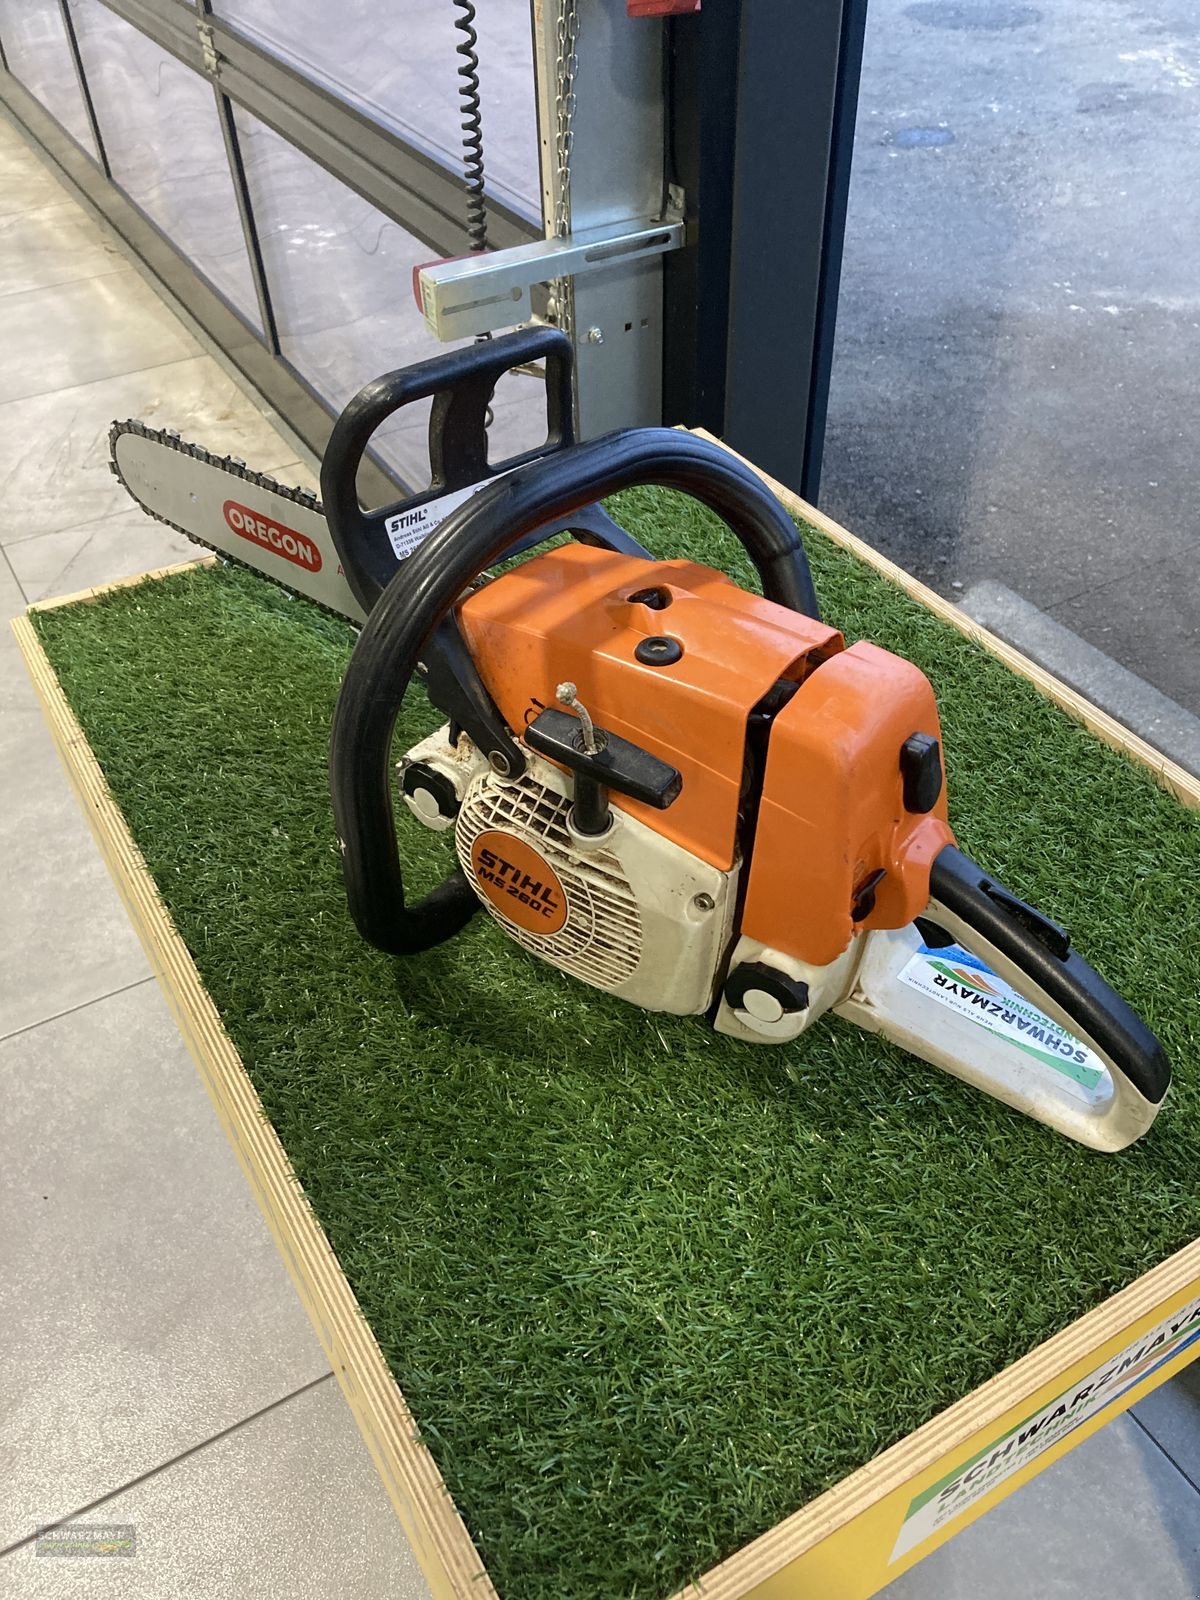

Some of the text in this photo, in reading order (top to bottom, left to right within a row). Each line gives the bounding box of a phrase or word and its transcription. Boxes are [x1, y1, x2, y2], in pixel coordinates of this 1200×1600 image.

[229, 508, 313, 565] OREGON
[477, 848, 558, 909] STIHL
[478, 866, 506, 889] MS
[933, 973, 1088, 1064] SCHWARZMAYR
[963, 1007, 975, 1016] ALS
[1000, 997, 1088, 1050] ANDTECHNIK
[937, 1395, 1097, 1514] LANDTECHNIK
